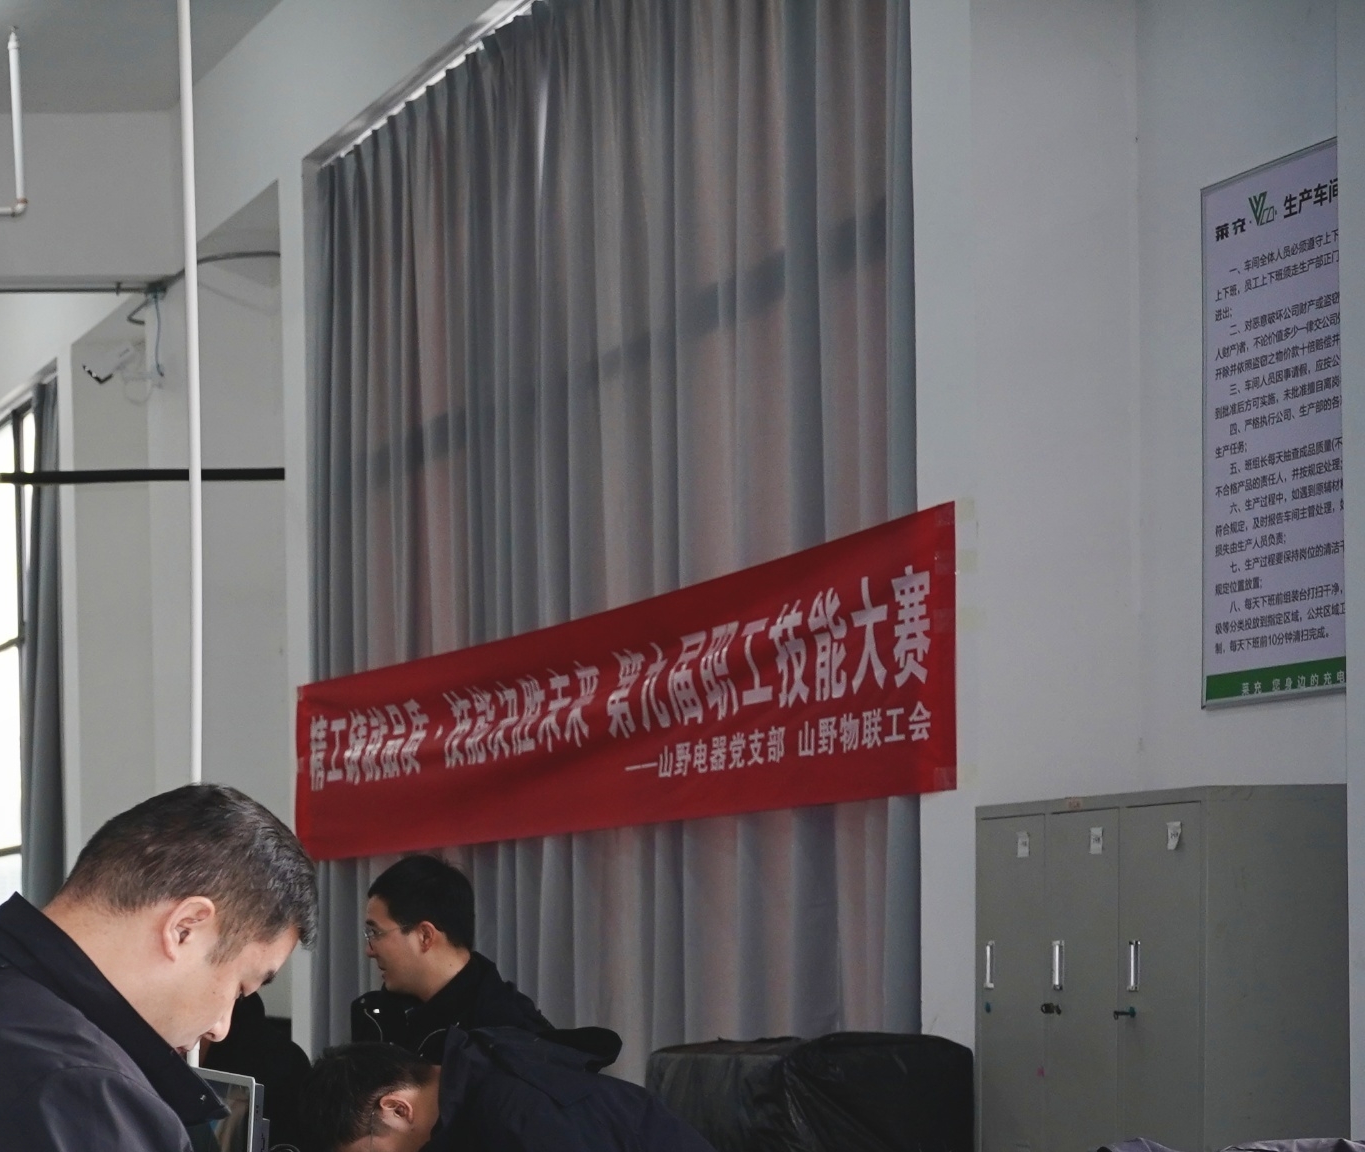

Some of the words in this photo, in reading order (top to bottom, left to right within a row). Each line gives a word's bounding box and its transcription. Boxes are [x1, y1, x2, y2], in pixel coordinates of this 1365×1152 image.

[1215, 217, 1246, 242] 莱充
[1283, 177, 1339, 219] 生产车间
[1215, 375, 1342, 420] 到批准后方可实施，未批准擅自离岗
[1229, 395, 1342, 436] 四、严格执行公司、生产部的各
[1215, 440, 1248, 460] 生产任务；
[1215, 531, 1287, 558] 损失由生产人员负责；
[605, 565, 932, 740] 第九届职工技能大赛
[797, 700, 933, 758] 山野物联工会
